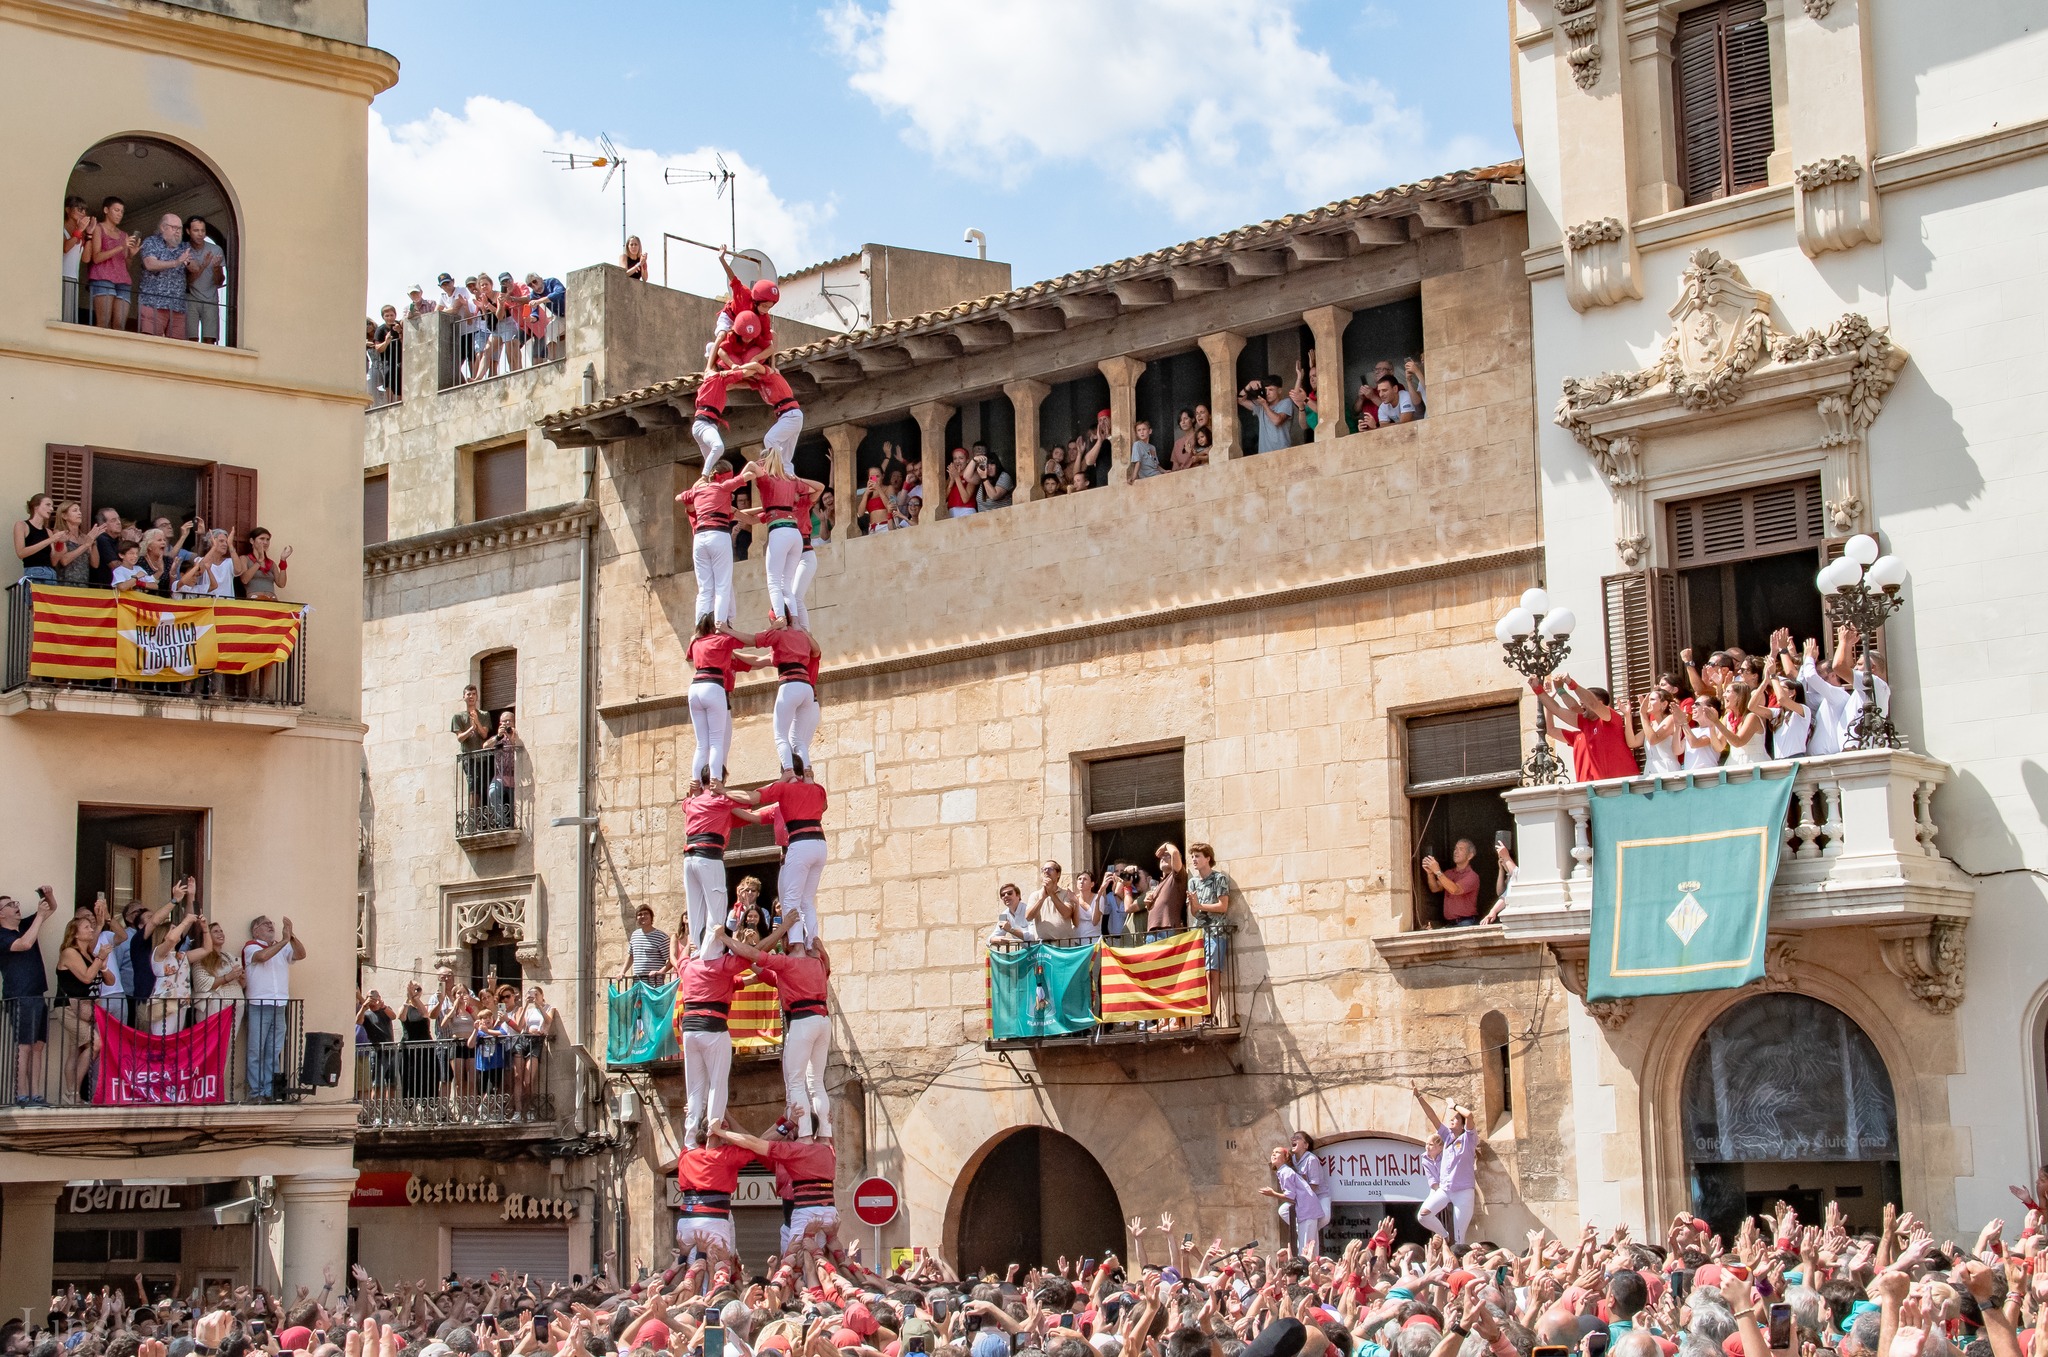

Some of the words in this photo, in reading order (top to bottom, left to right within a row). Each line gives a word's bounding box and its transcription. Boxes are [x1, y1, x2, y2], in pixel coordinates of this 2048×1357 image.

[136, 622, 197, 647] REPÚBLICA
[136, 643, 197, 671] LLIBERTAT
[124, 1069, 172, 1084] VSCA
[1225, 1140, 1237, 1150] 16
[1339, 1178, 1371, 1187] Vilafranca
[1372, 1178, 1383, 1187] del
[1337, 1229, 1374, 1240] setemb
